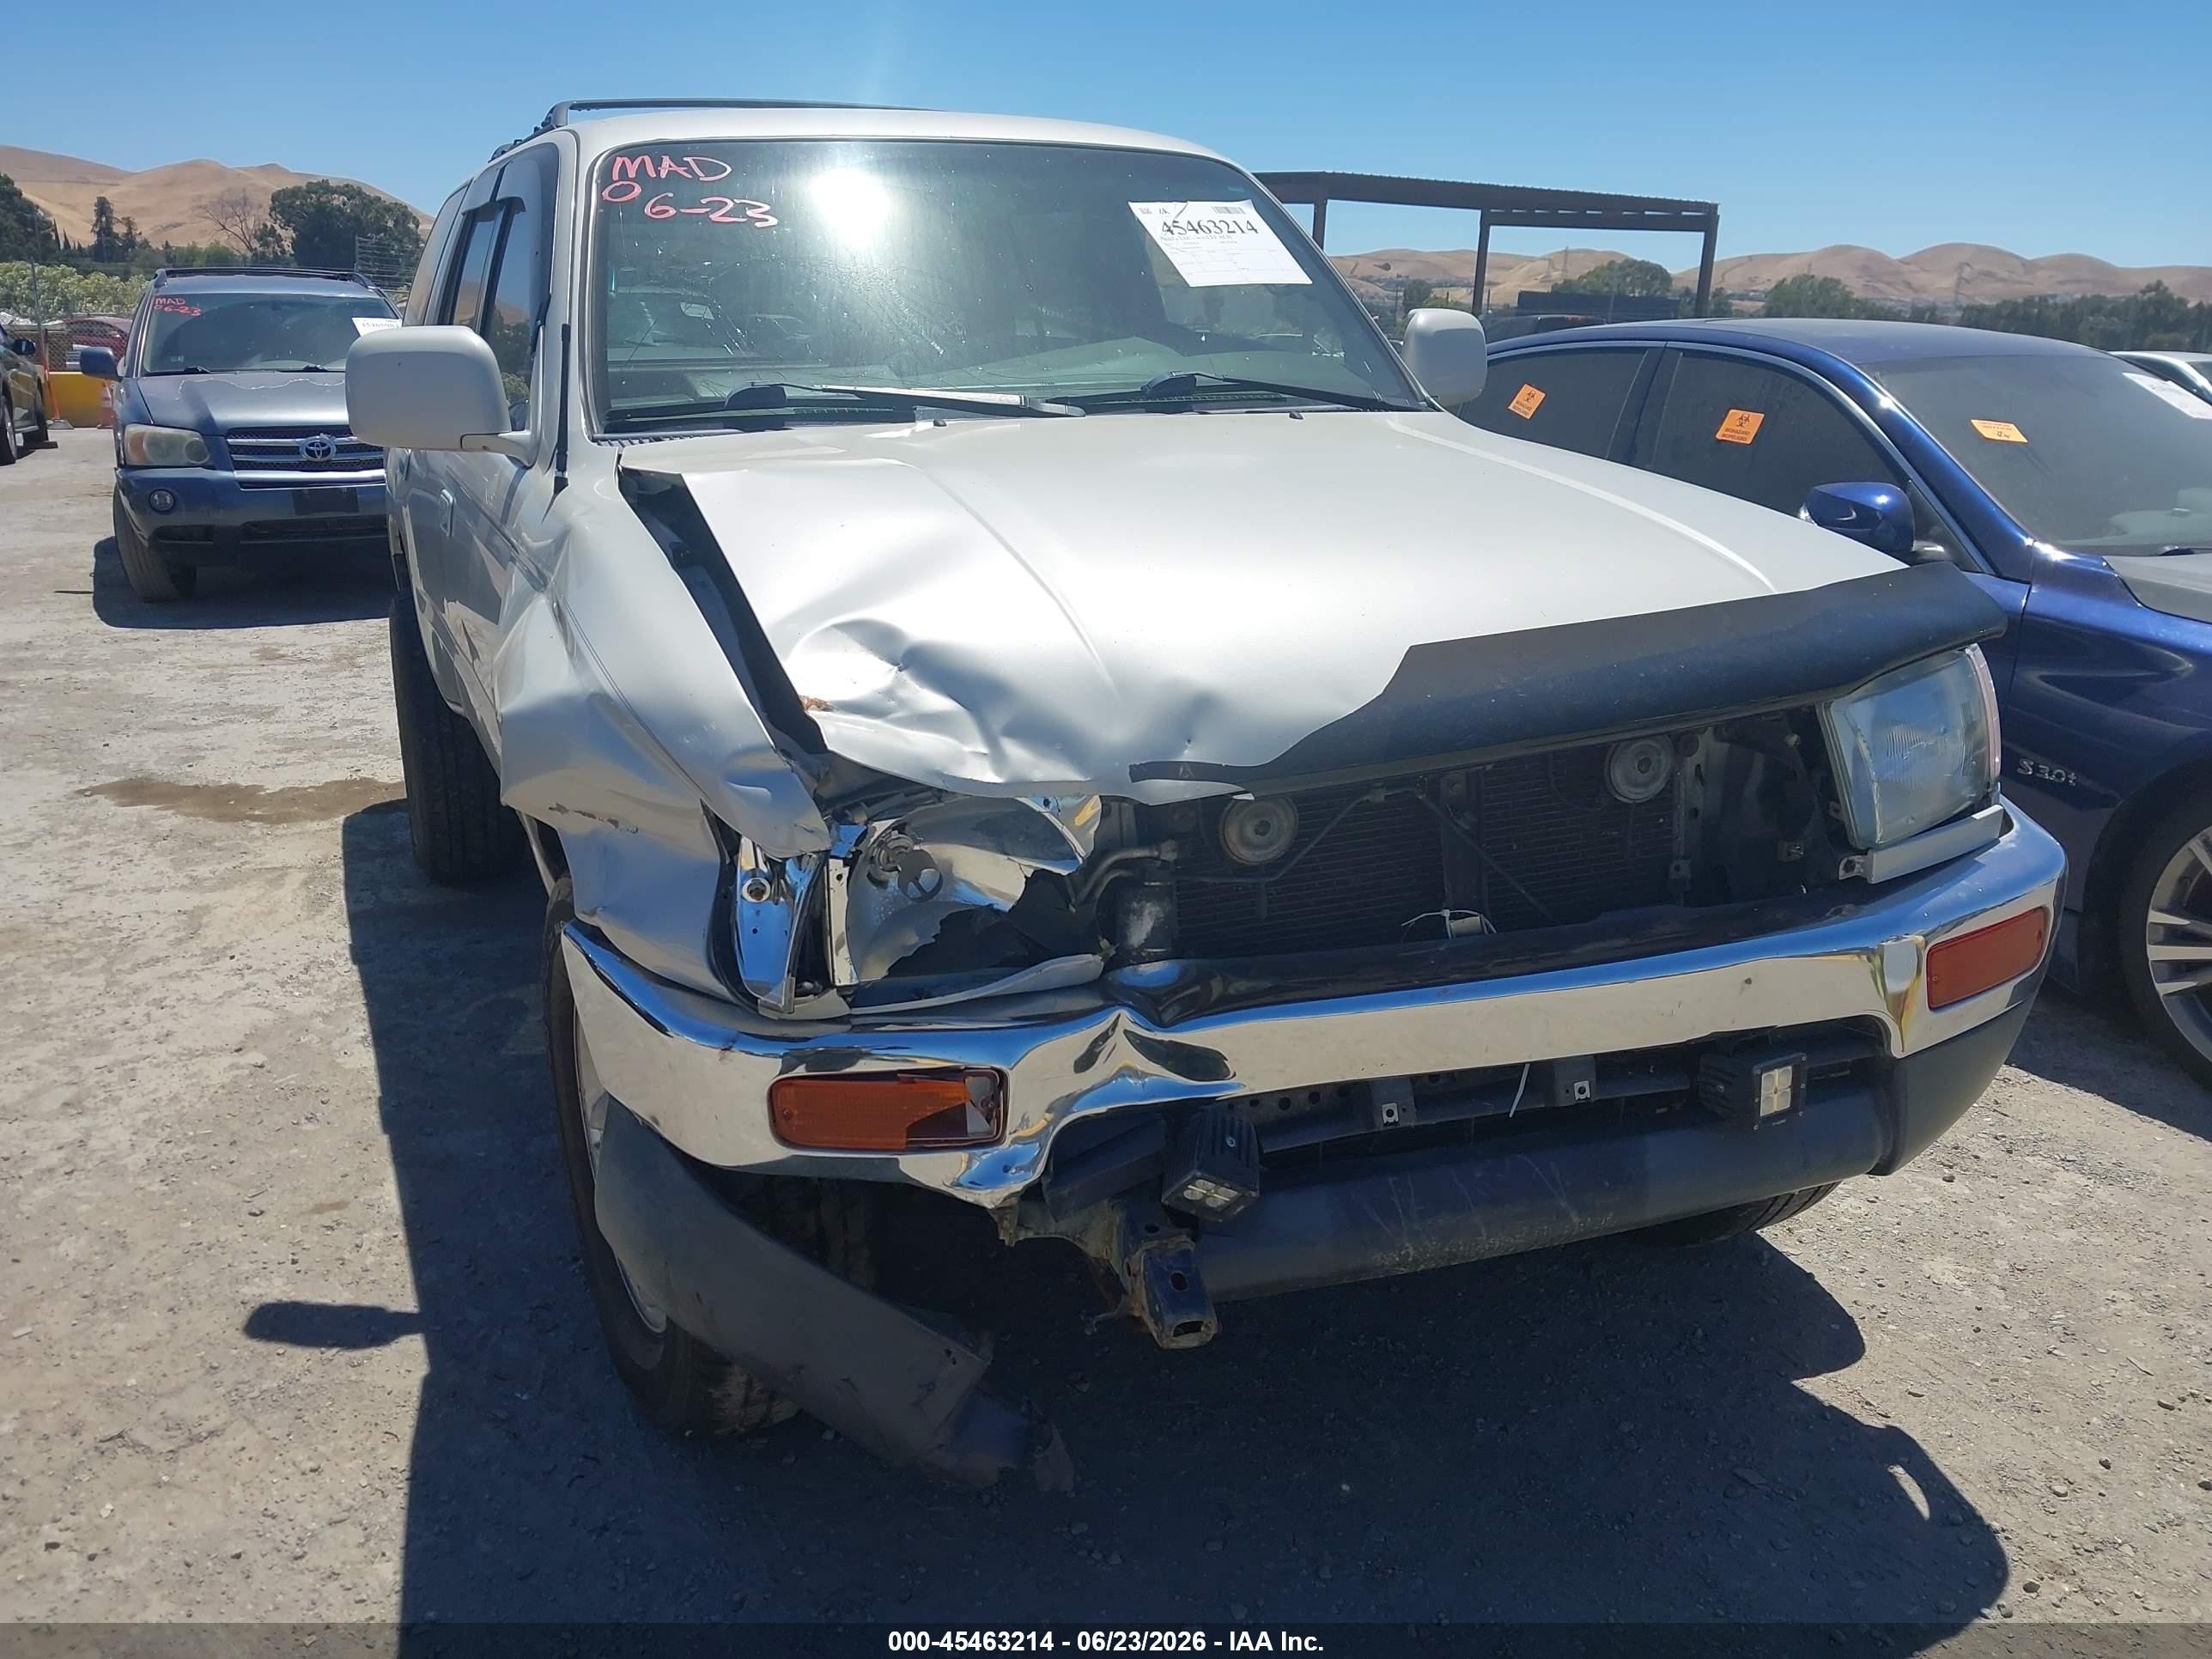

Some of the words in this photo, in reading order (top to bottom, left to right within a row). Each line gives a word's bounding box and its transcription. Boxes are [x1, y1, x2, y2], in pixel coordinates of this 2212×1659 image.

[611, 155, 732, 181] MAD
[1162, 220, 1259, 234] 45463214
[154, 305, 202, 316] 06-23
